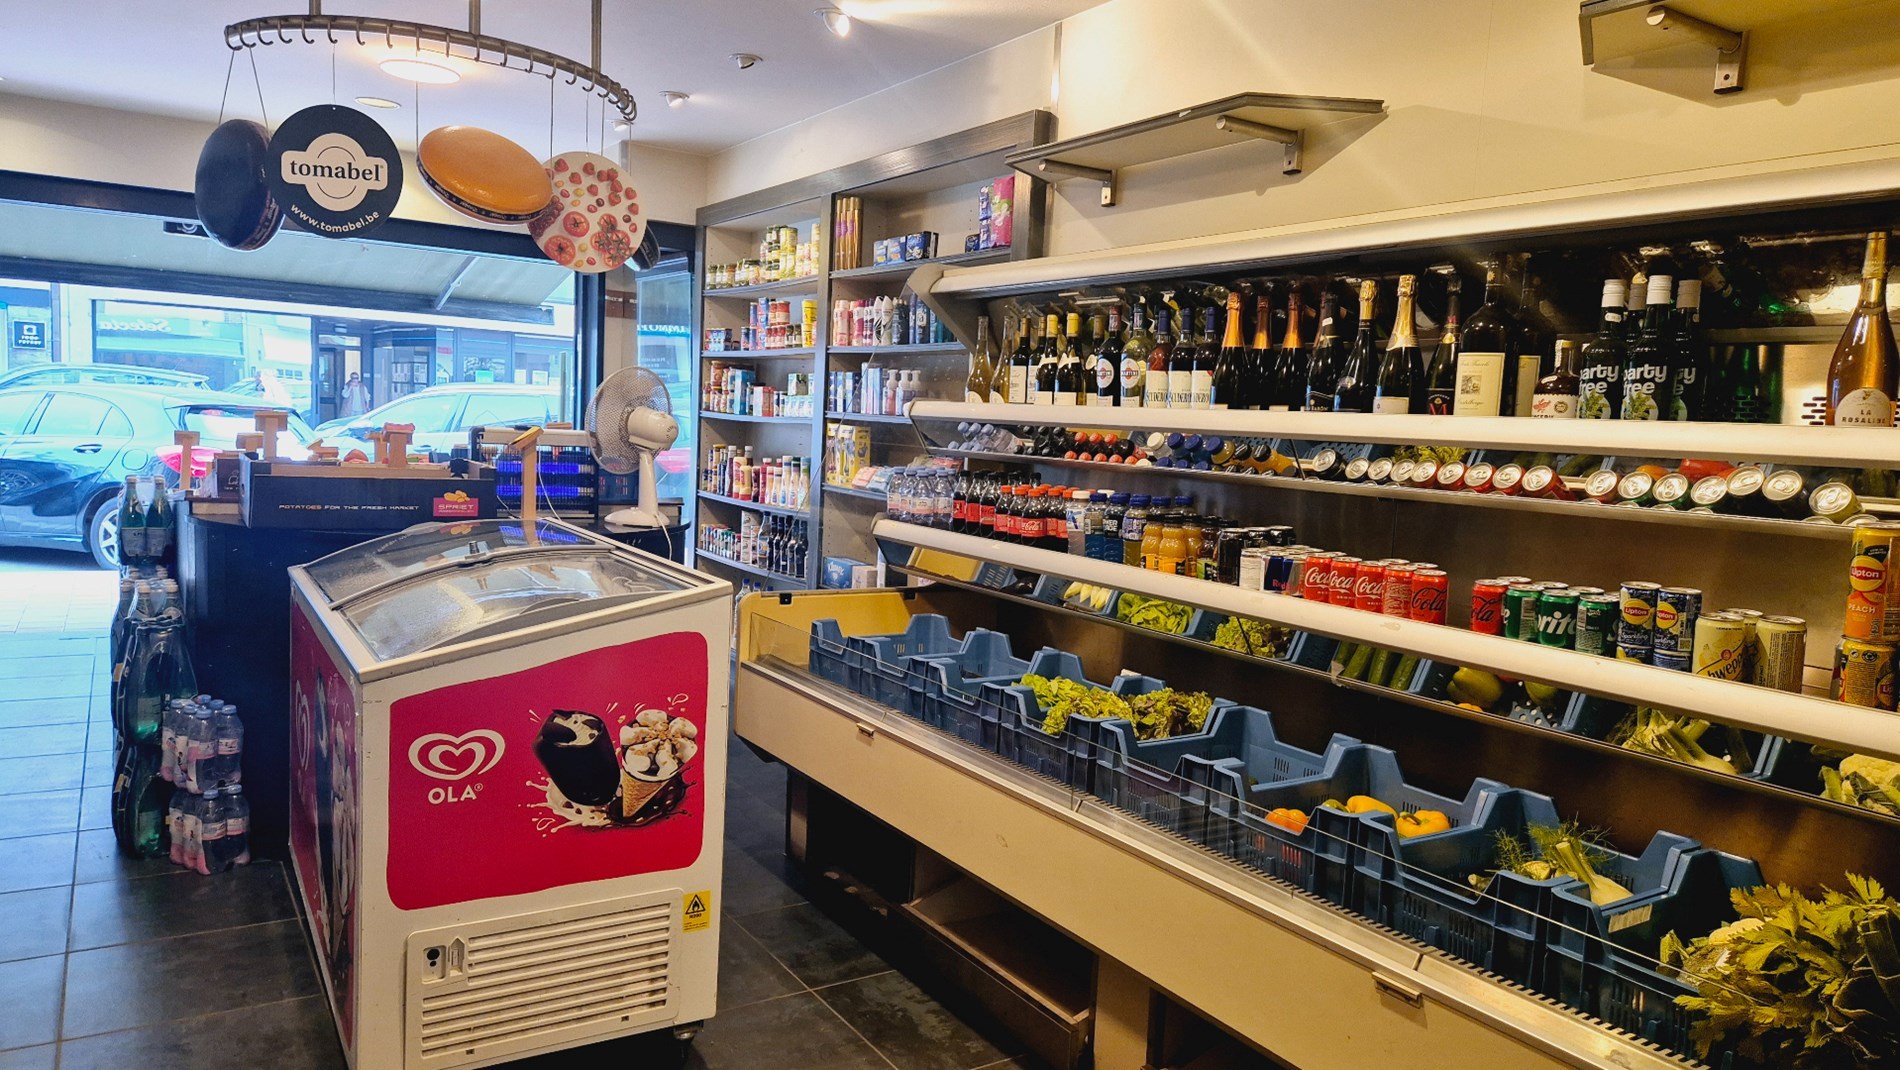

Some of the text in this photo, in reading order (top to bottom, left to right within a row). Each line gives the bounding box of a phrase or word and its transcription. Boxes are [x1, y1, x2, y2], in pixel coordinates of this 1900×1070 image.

[290, 160, 381, 181] tomabel
[291, 204, 380, 233] www.tomabel.be
[1623, 380, 1656, 396] free
[1851, 566, 1879, 579] Lipton
[1624, 607, 1648, 616] Lipton
[1848, 603, 1876, 614] PEACH
[427, 784, 477, 805] OLA
